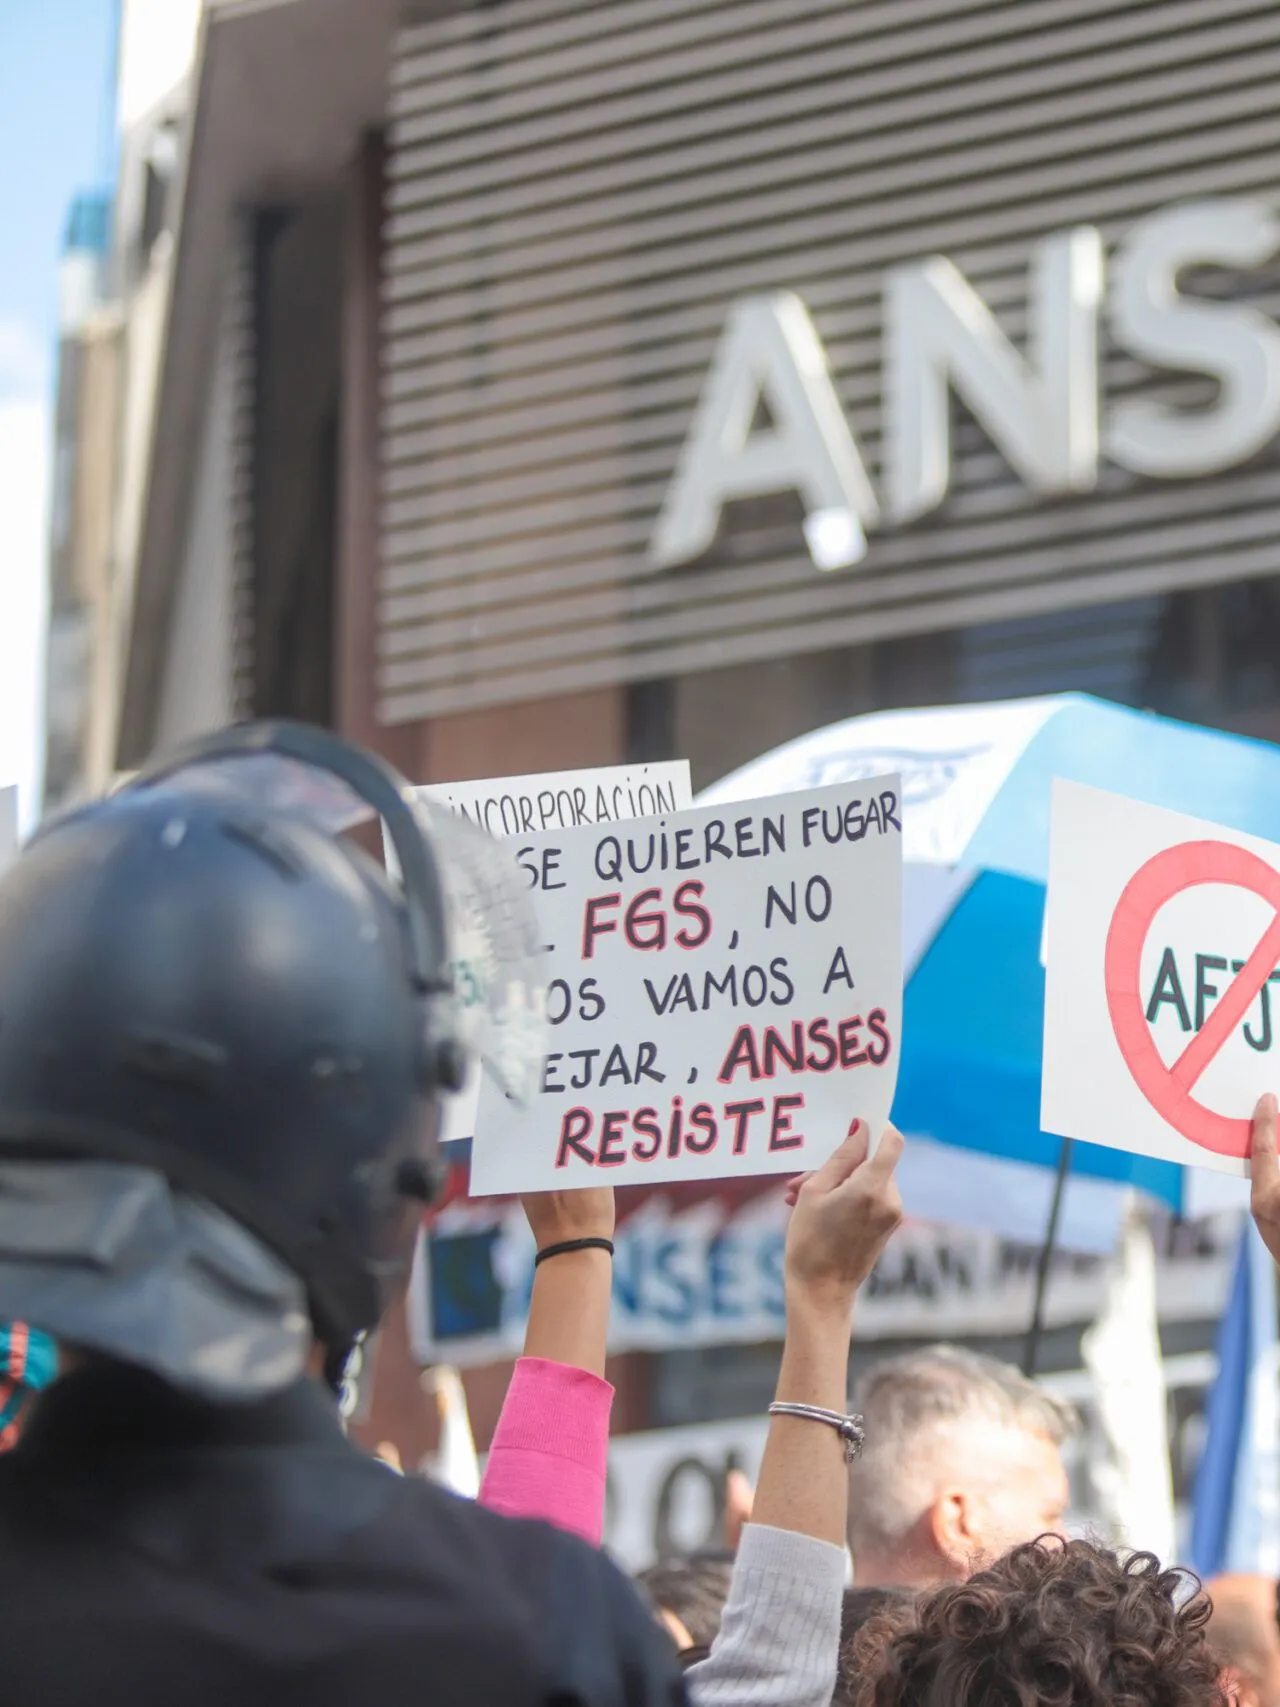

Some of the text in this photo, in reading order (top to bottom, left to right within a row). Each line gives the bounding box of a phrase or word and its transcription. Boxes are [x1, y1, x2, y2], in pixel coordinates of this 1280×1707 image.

[517, 846, 567, 891] SE
[802, 790, 901, 848] FUGAR
[764, 874, 833, 929] NO
[547, 976, 607, 1025] OS
[643, 956, 795, 1016] VAMOS
[822, 945, 855, 994] A
[541, 1007, 892, 1094] EJAR, ANSES
